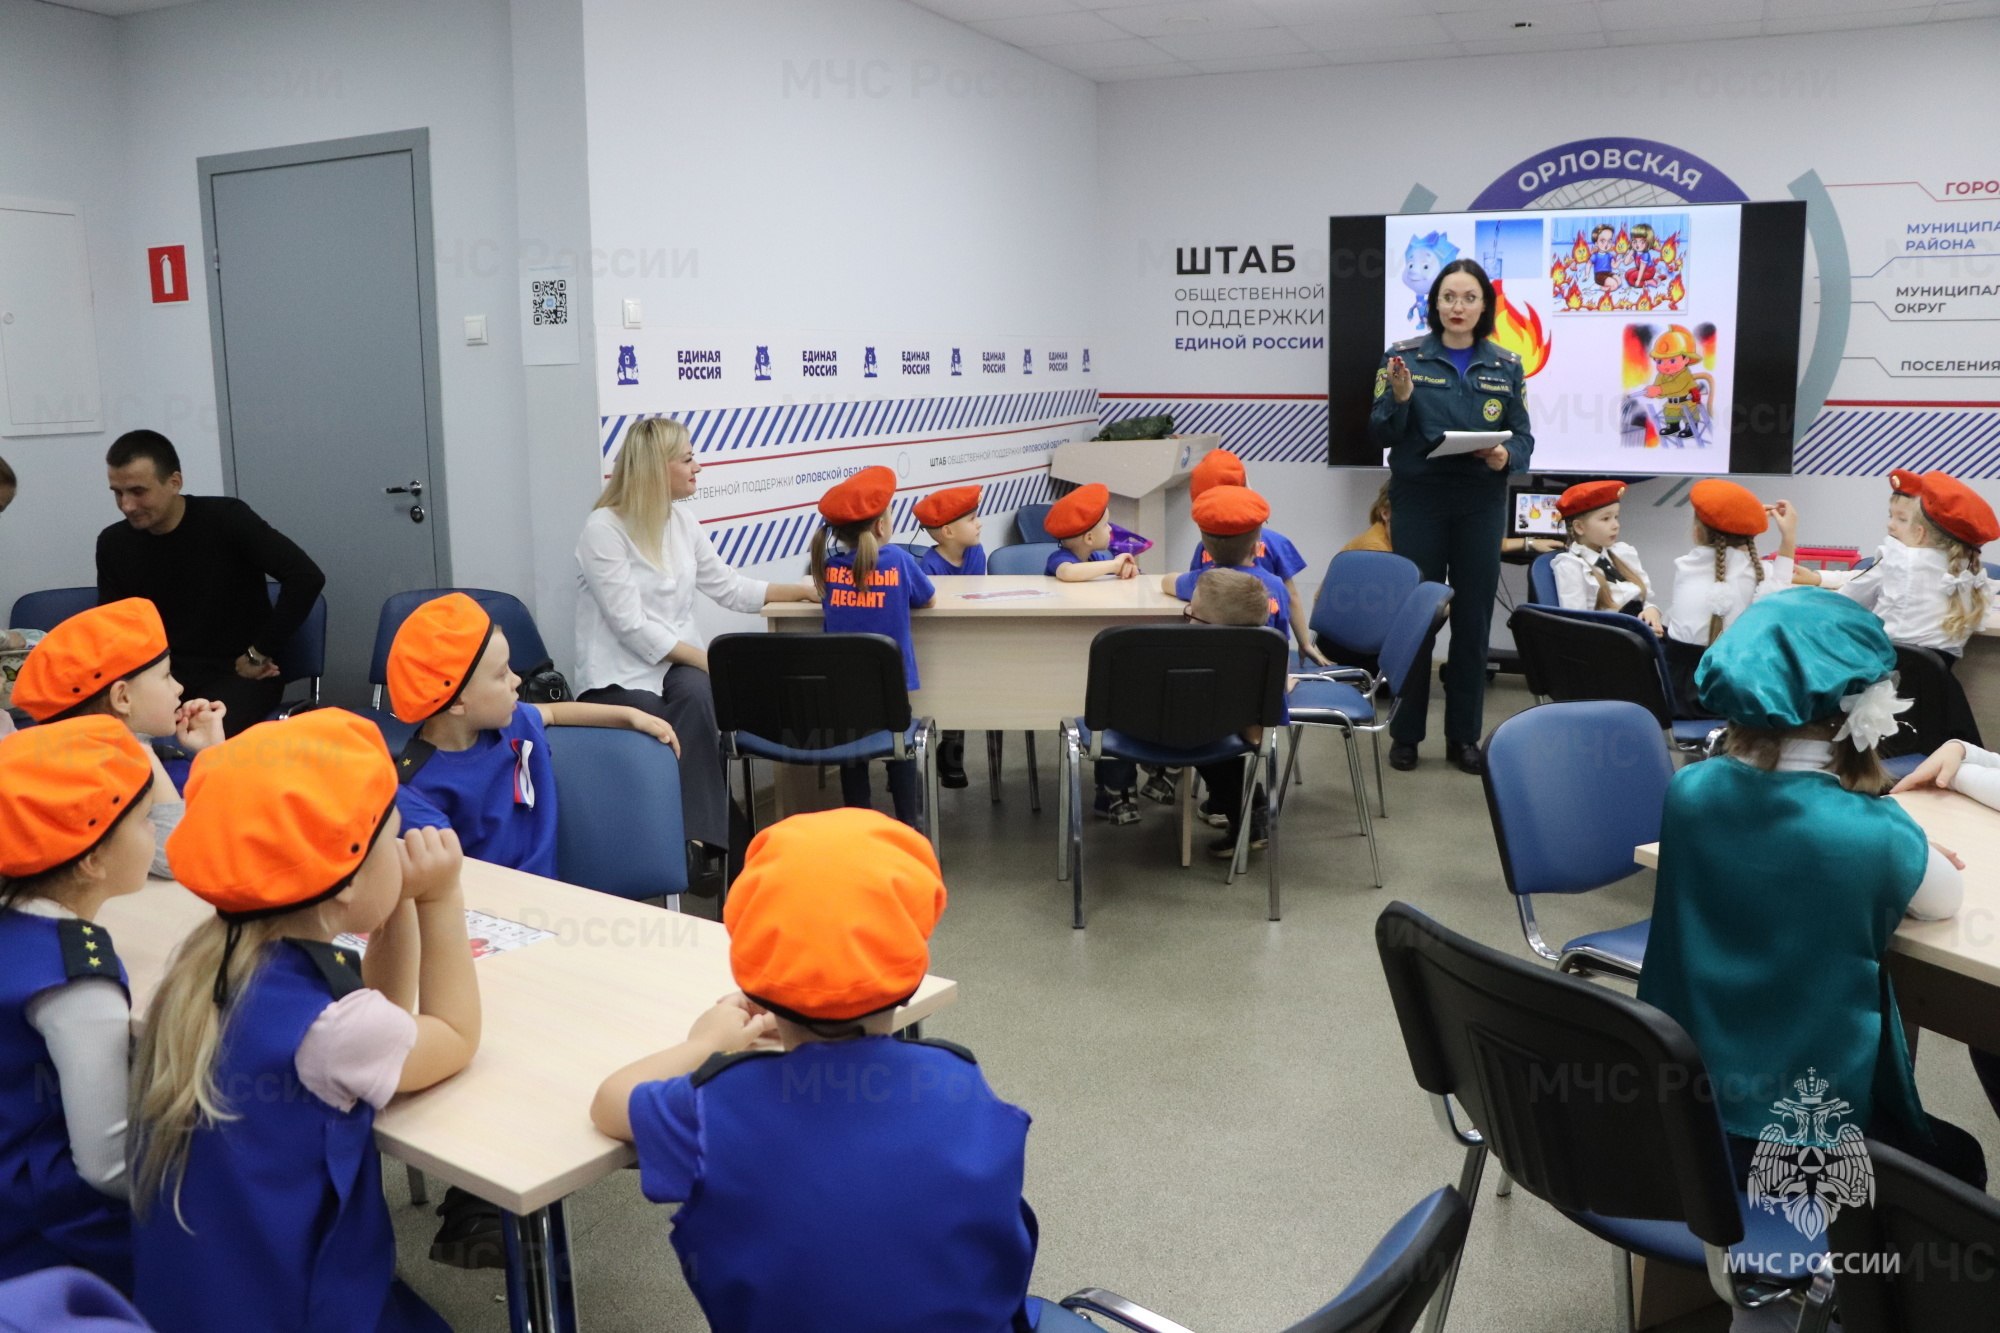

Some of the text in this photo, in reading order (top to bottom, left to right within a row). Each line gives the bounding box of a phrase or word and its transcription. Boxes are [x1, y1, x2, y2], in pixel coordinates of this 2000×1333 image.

[1518, 148, 1703, 192] ОРЛОВСКАЯ
[1945, 180, 2000, 195] ГОРО
[1905, 237, 1976, 251] РАЙОНА
[1176, 244, 1296, 275] ШТАБ
[1174, 283, 1325, 303] ОБЩЕСТВЕННОЙ
[1894, 302, 1947, 314] ОКРУГ
[1175, 308, 1324, 329] ПОДДЕРЖКИ
[1175, 334, 1324, 352] ЕДИНОЙ РОССИИ
[677, 349, 721, 365] ЕДИНАЯ
[802, 350, 837, 363] ЕДИНАЯ
[901, 351, 930, 363] ЕДИНАЯ
[982, 351, 1006, 362] ЕДИНАЯ
[1048, 351, 1068, 361] ЕДИНАЯ
[802, 364, 838, 377] РОССИЯ
[902, 363, 930, 375] РОССИЯ
[982, 363, 1006, 374] РОССИЯ
[1048, 362, 1068, 372] РОССИЯ
[1900, 359, 2000, 371] ПОСЕЛЕНИЯ
[678, 366, 722, 380] РОССИЯ
[929, 457, 947, 467] ШТАБ
[947, 449, 991, 465] ОБЩЕСТВЕННОЙ
[742, 475, 794, 494] ПОДДЕРЖКИ
[795, 466, 842, 485] ОРЛОВСКОЙ
[830, 589, 886, 608] ДЕСАНТ
